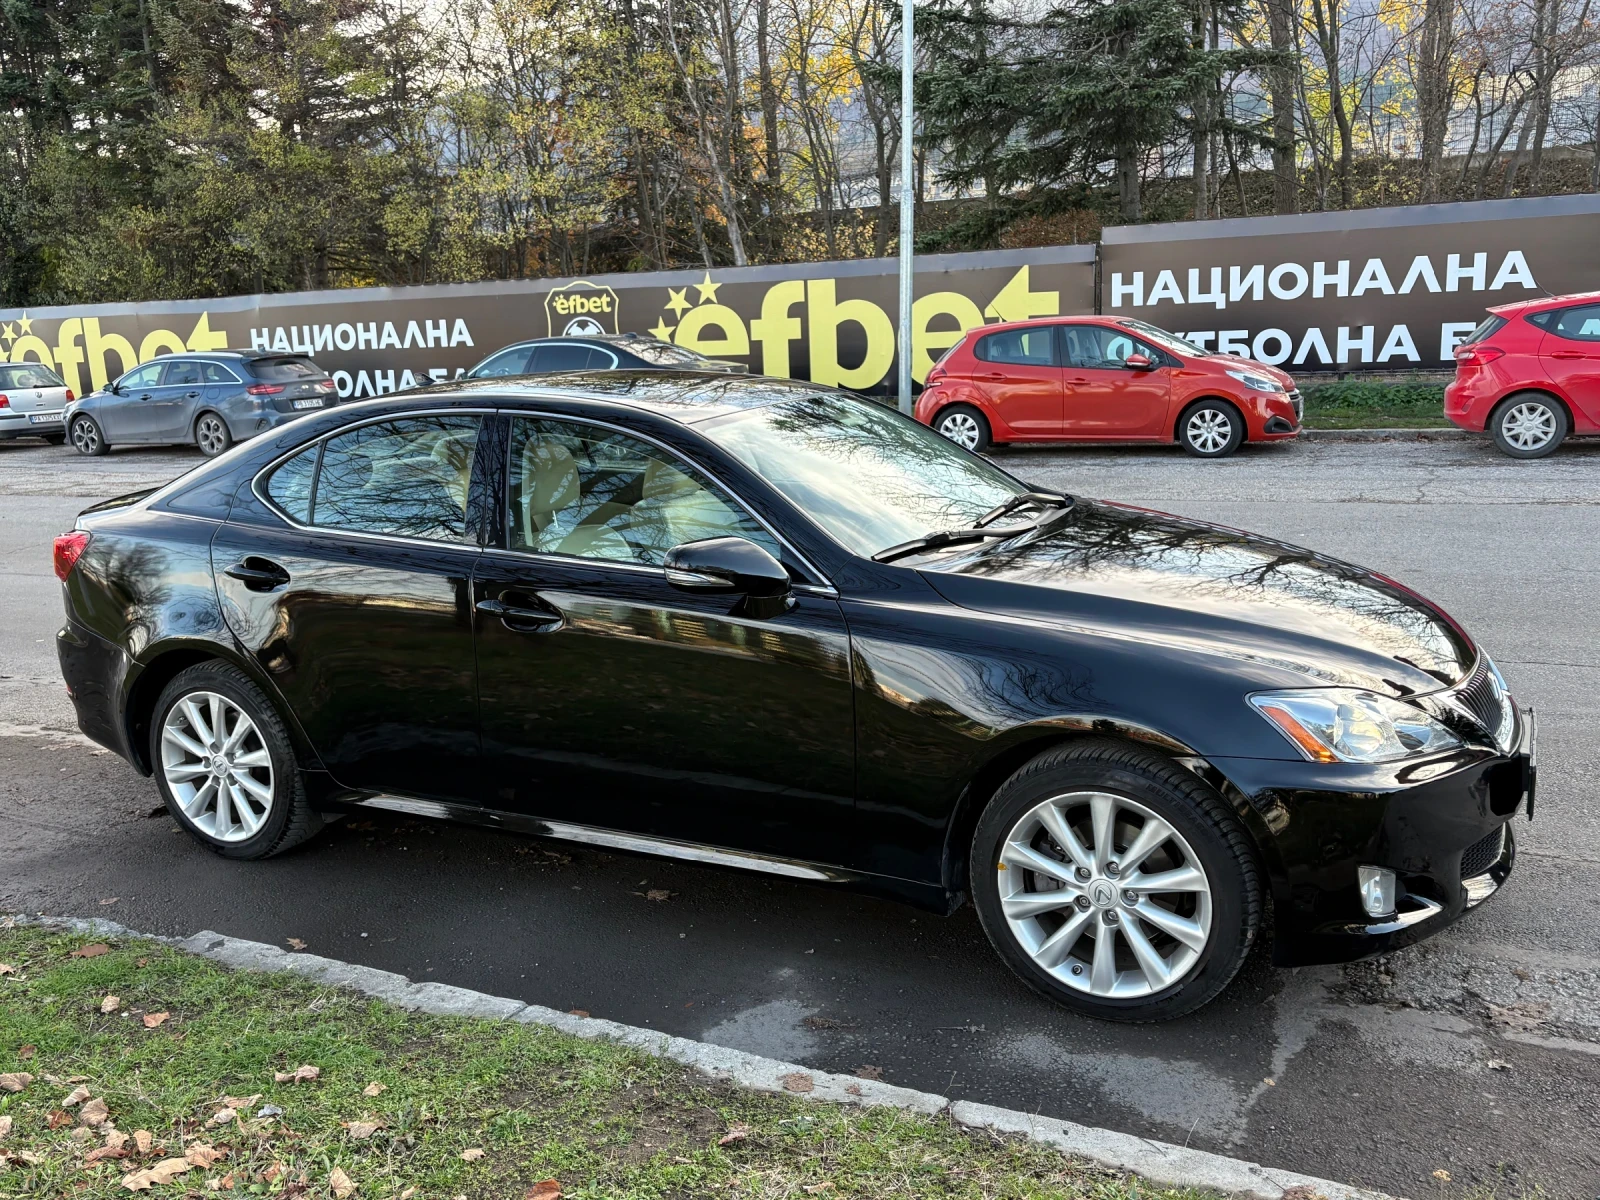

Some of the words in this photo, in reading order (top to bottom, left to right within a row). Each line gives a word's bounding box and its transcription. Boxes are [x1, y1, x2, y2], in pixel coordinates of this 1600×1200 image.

[1110, 250, 1537, 309] НАЦИОНАЛНА
[555, 293, 612, 315] efbet
[250, 318, 475, 353] НАЦИОНАЛНА
